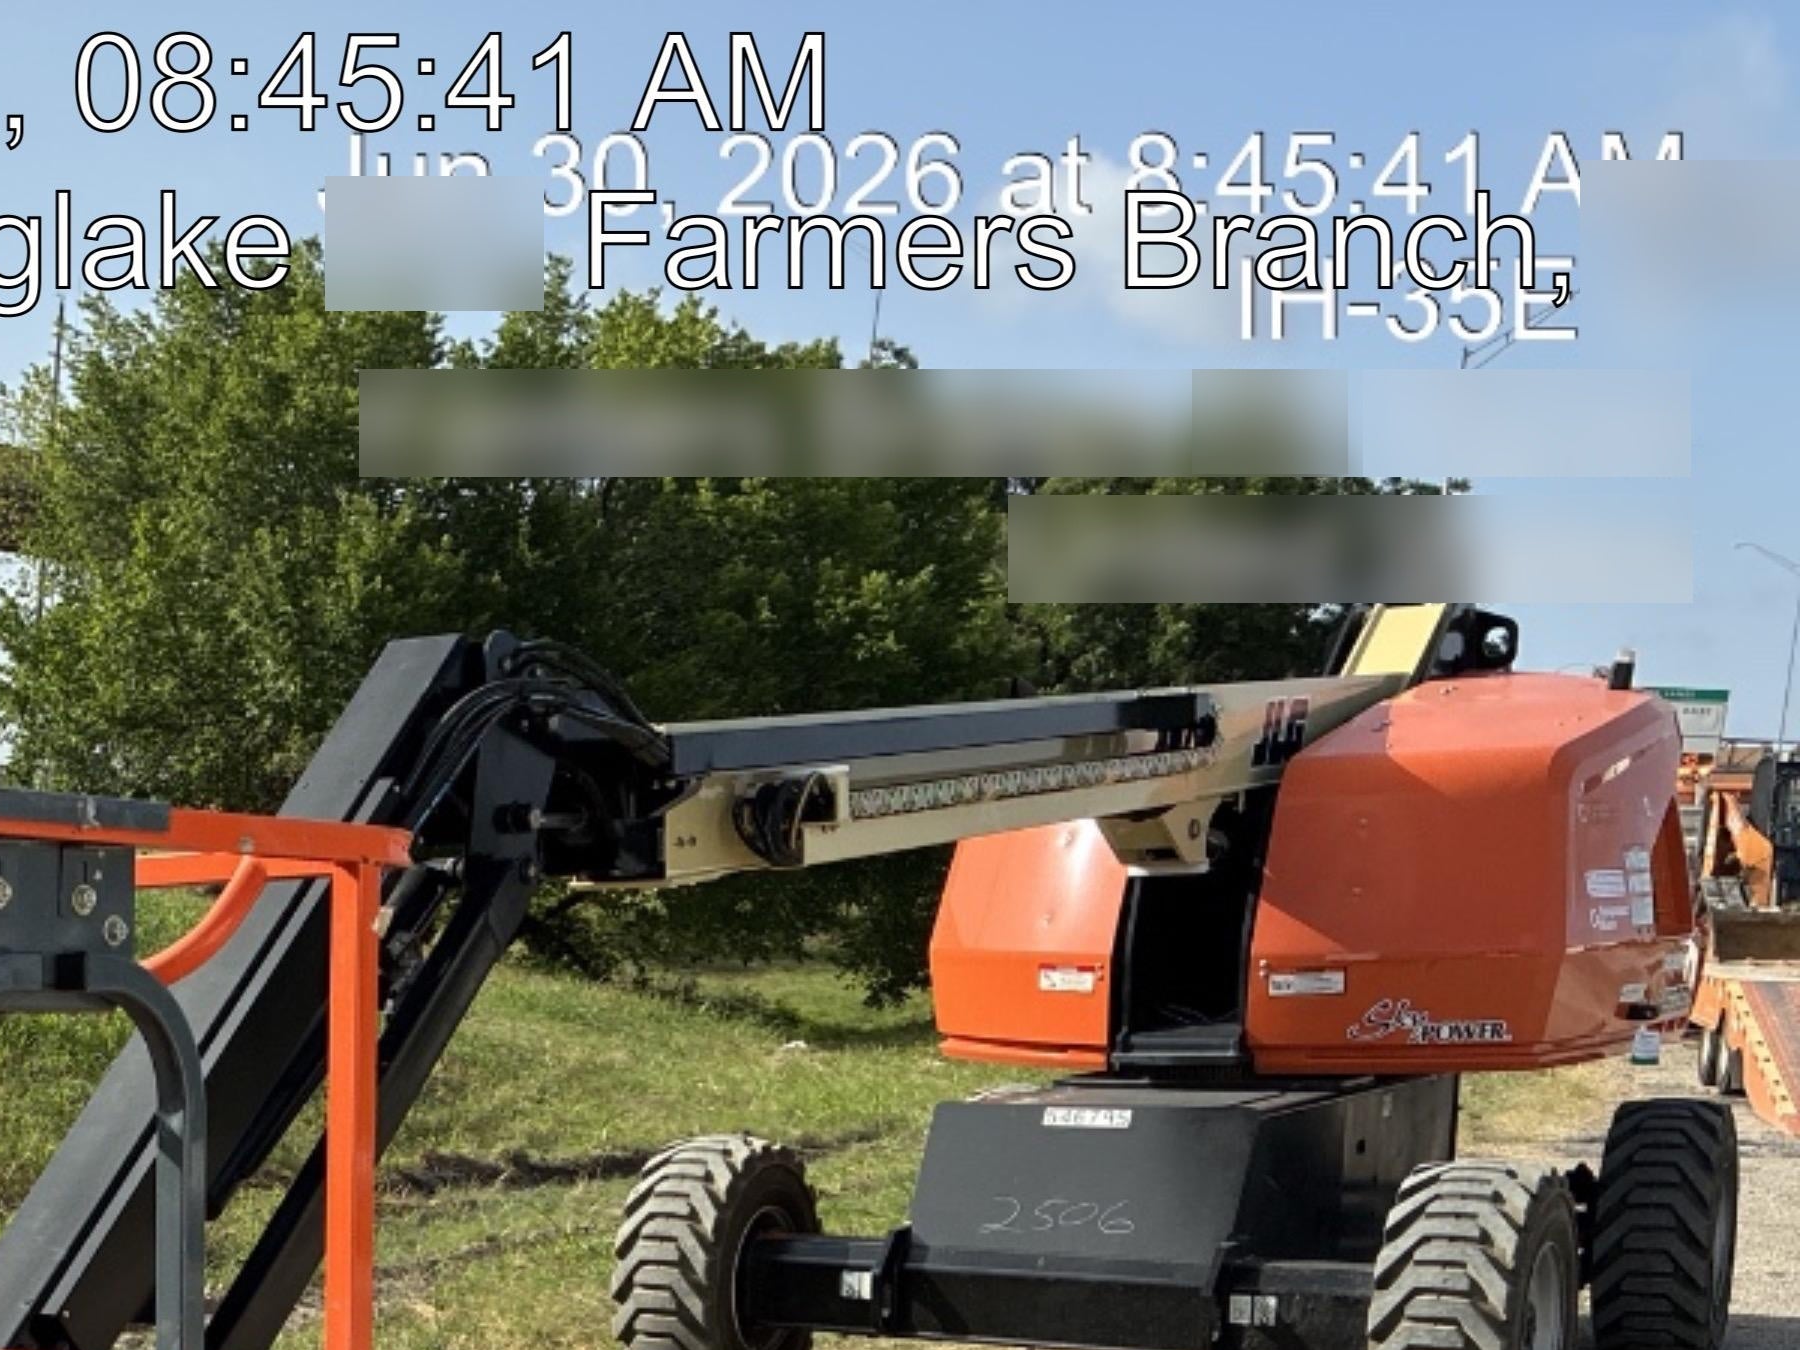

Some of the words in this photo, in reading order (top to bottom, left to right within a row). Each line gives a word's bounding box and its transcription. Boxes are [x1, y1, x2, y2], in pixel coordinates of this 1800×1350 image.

[1347, 998, 1430, 1044] Sky
[1416, 1021, 1511, 1044] POWER
[977, 1195, 1136, 1235] 2506
